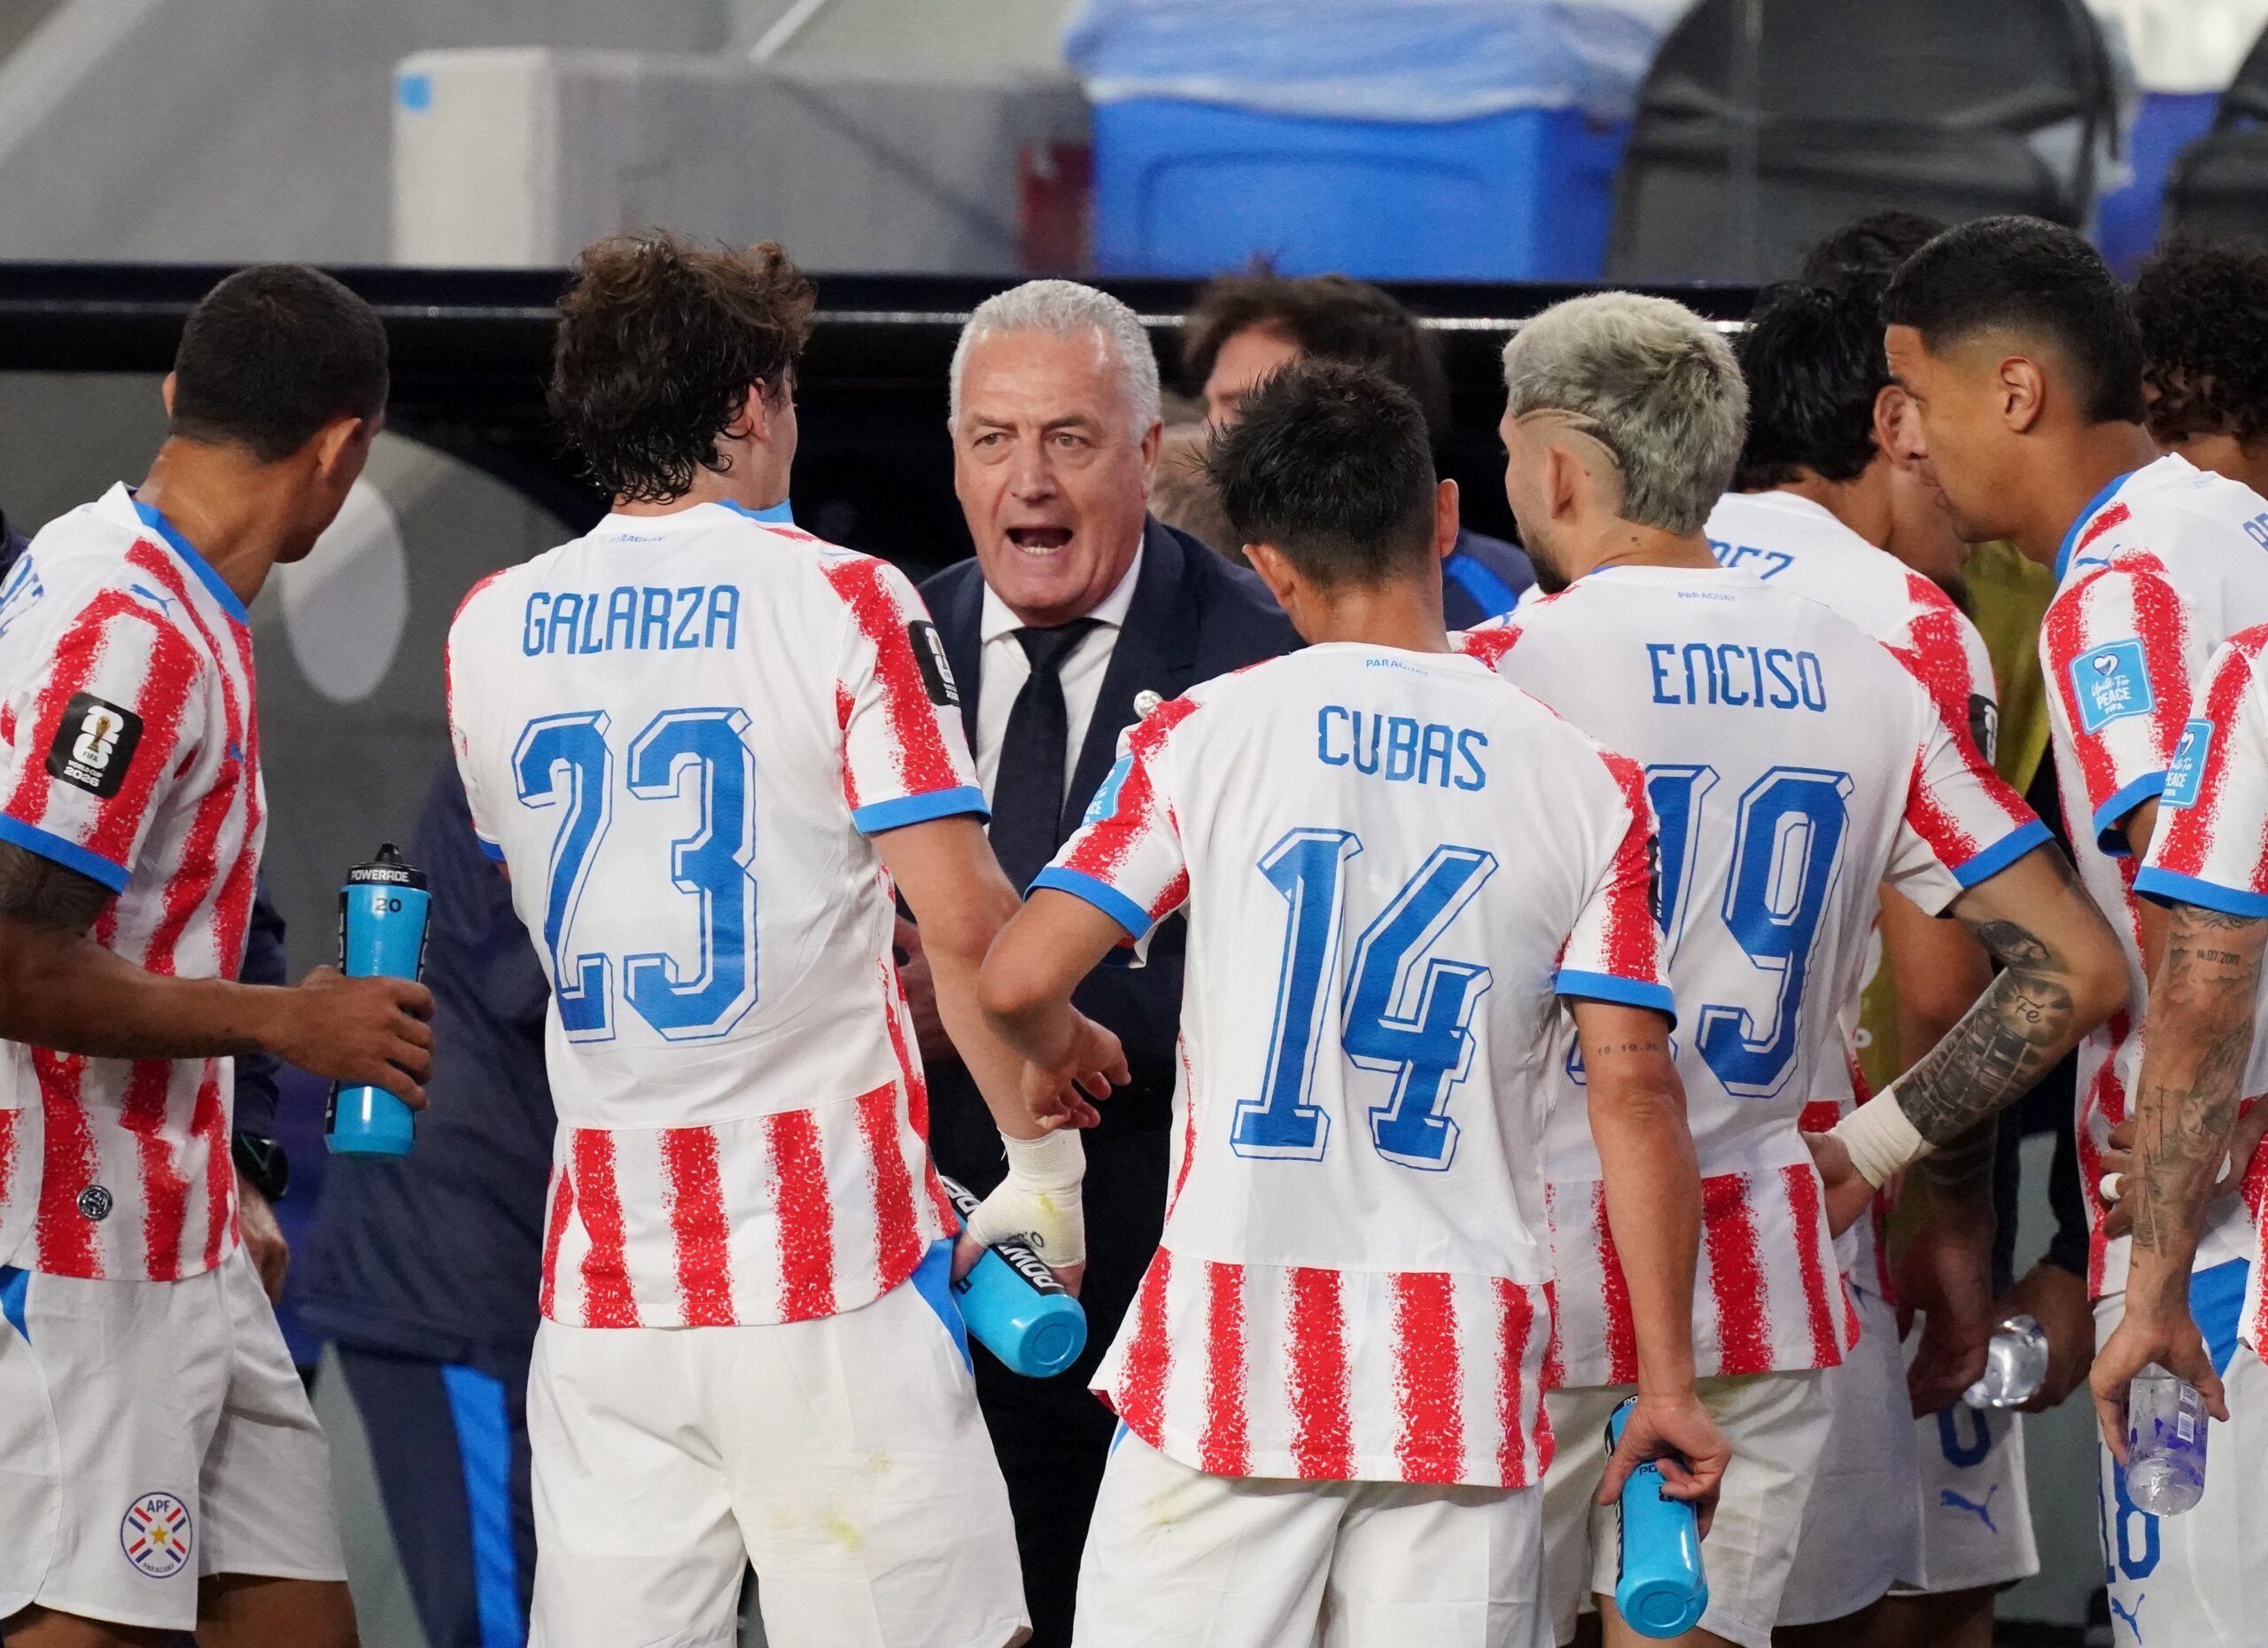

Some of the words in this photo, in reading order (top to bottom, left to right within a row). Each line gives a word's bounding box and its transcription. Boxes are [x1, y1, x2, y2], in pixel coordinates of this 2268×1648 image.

[522, 585, 741, 657] GALARZA
[1645, 642, 1828, 713] ENCISO
[2095, 687, 2132, 710] PEACE
[82, 750, 98, 763] FIFA
[1317, 704, 1489, 792] CUBAS
[63, 766, 100, 788] 2026
[351, 869, 410, 882] POWERADE
[510, 707, 759, 1044] 23
[375, 898, 402, 913] 20
[1230, 827, 1499, 1172] 14
[146, 1499, 171, 1513] APF
[143, 1562, 175, 1574] PARAGUAY
